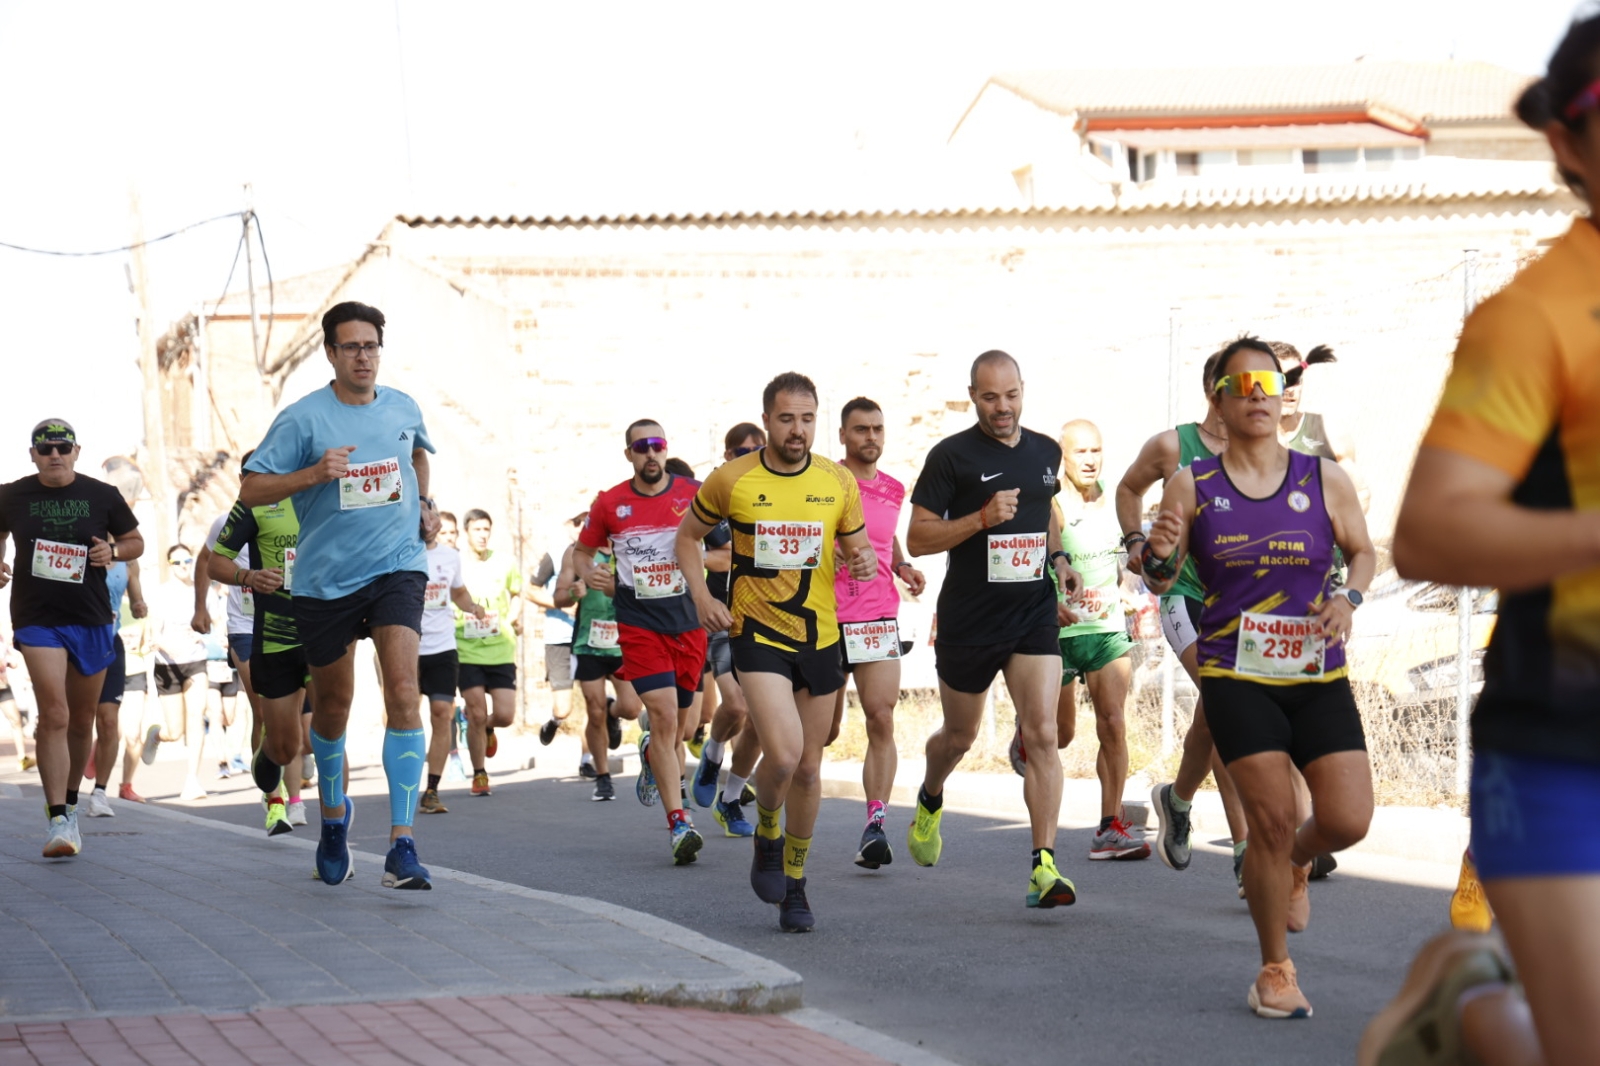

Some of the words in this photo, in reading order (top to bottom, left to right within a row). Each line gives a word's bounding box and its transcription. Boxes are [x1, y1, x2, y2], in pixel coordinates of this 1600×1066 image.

[362, 477, 381, 494] 61
[63, 500, 90, 509] CROSS
[40, 508, 90, 517] CABRERIZOS
[757, 523, 822, 537] bedunia
[779, 538, 799, 555] 33
[1214, 533, 1249, 545] Jamón
[1268, 541, 1305, 552] PRIM
[36, 541, 86, 558] bedunia
[48, 554, 72, 571] 164
[1011, 551, 1031, 568] 64
[1260, 555, 1310, 566] Macotera
[648, 573, 671, 588] 298
[845, 625, 896, 636] bedunia
[864, 635, 880, 650] 95
[1262, 637, 1303, 659] 238
